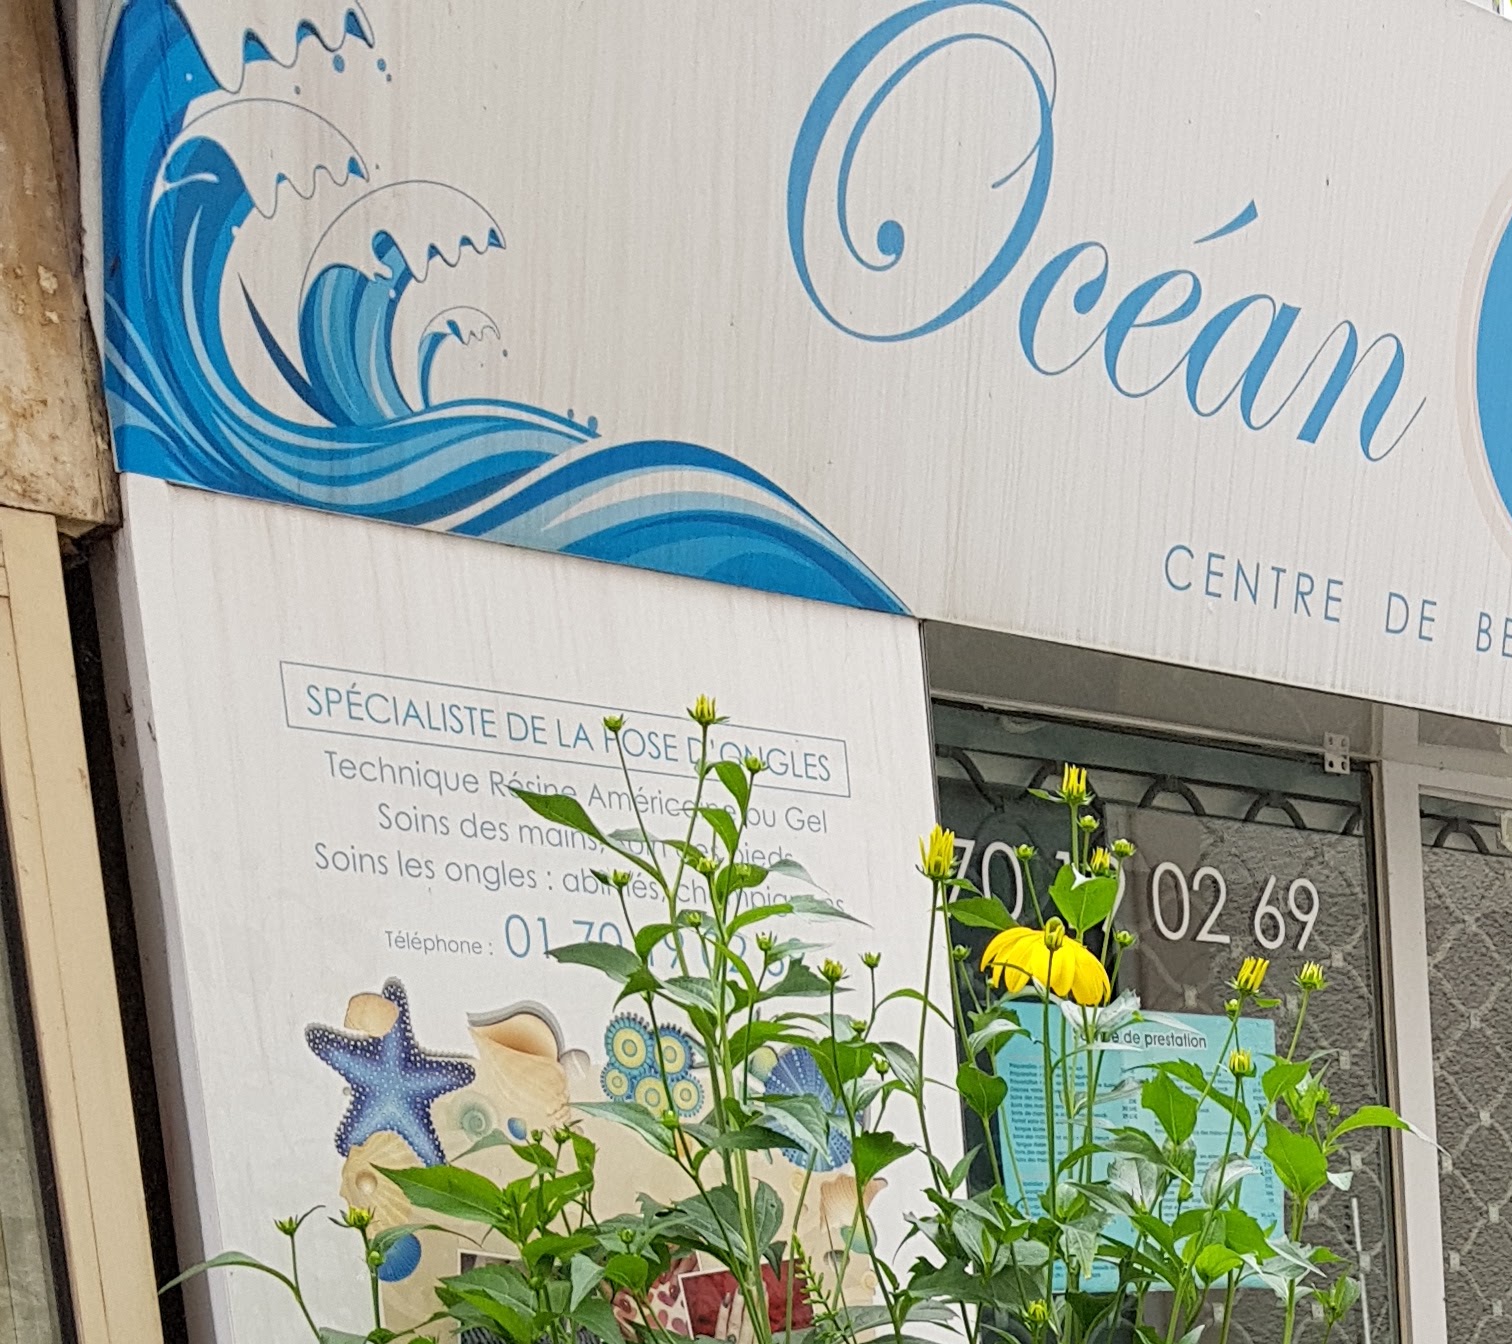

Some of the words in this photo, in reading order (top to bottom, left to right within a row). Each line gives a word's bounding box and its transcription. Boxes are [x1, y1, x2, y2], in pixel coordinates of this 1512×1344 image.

[787, 0, 1426, 462] Océan
[1163, 544, 1344, 623] CENTRE
[1385, 592, 1438, 642] DE
[306, 682, 498, 738] SPÉCIALISTE
[506, 712, 548, 745] DE
[557, 719, 594, 751] LA
[324, 750, 480, 797] Technique
[746, 807, 776, 828] ou
[785, 806, 828, 834] Gel
[378, 802, 450, 836] Soins
[460, 812, 509, 842] des
[314, 842, 388, 876] Soins
[397, 850, 435, 880] les
[445, 860, 537, 891] ongles
[385, 930, 482, 955] Téléphone
[505, 914, 550, 958] 01
[1152, 862, 1231, 944] 02
[1254, 874, 1320, 952] 69
[1124, 1030, 1140, 1044] de
[1145, 1032, 1207, 1049] prestation
